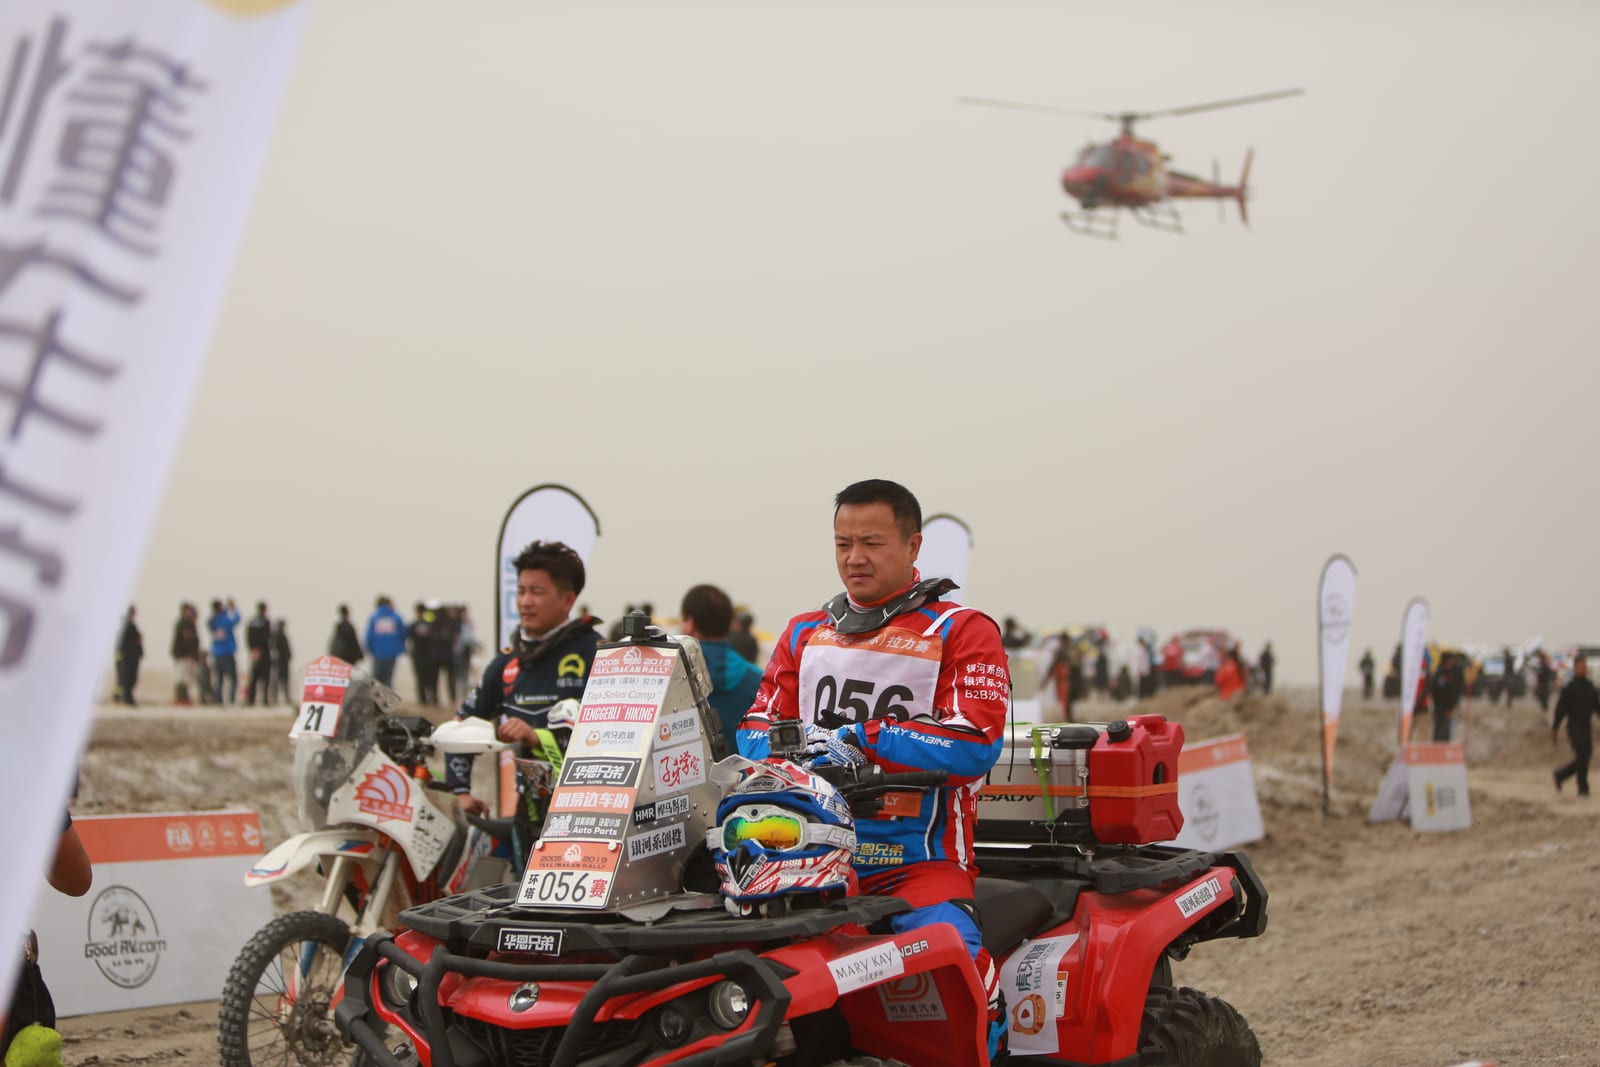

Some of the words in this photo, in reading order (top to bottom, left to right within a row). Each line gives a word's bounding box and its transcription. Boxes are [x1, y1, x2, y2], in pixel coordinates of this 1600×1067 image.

[642, 666, 670, 674] RALLY
[813, 675, 914, 723] 056
[303, 704, 325, 732] 21
[624, 706, 655, 721] HIKING
[908, 731, 954, 748] SABINE
[572, 764, 625, 779] 华恩兄弟
[635, 809, 655, 822] HMR
[572, 826, 592, 834] Auto
[594, 827, 618, 836] Parts
[582, 856, 608, 864] 2019
[538, 871, 589, 902] 056
[589, 878, 608, 899] 赛
[85, 942, 117, 958] Good
[504, 934, 554, 951] 华恩兄弟
[835, 957, 869, 981] MARY
[871, 950, 894, 968] KAY
